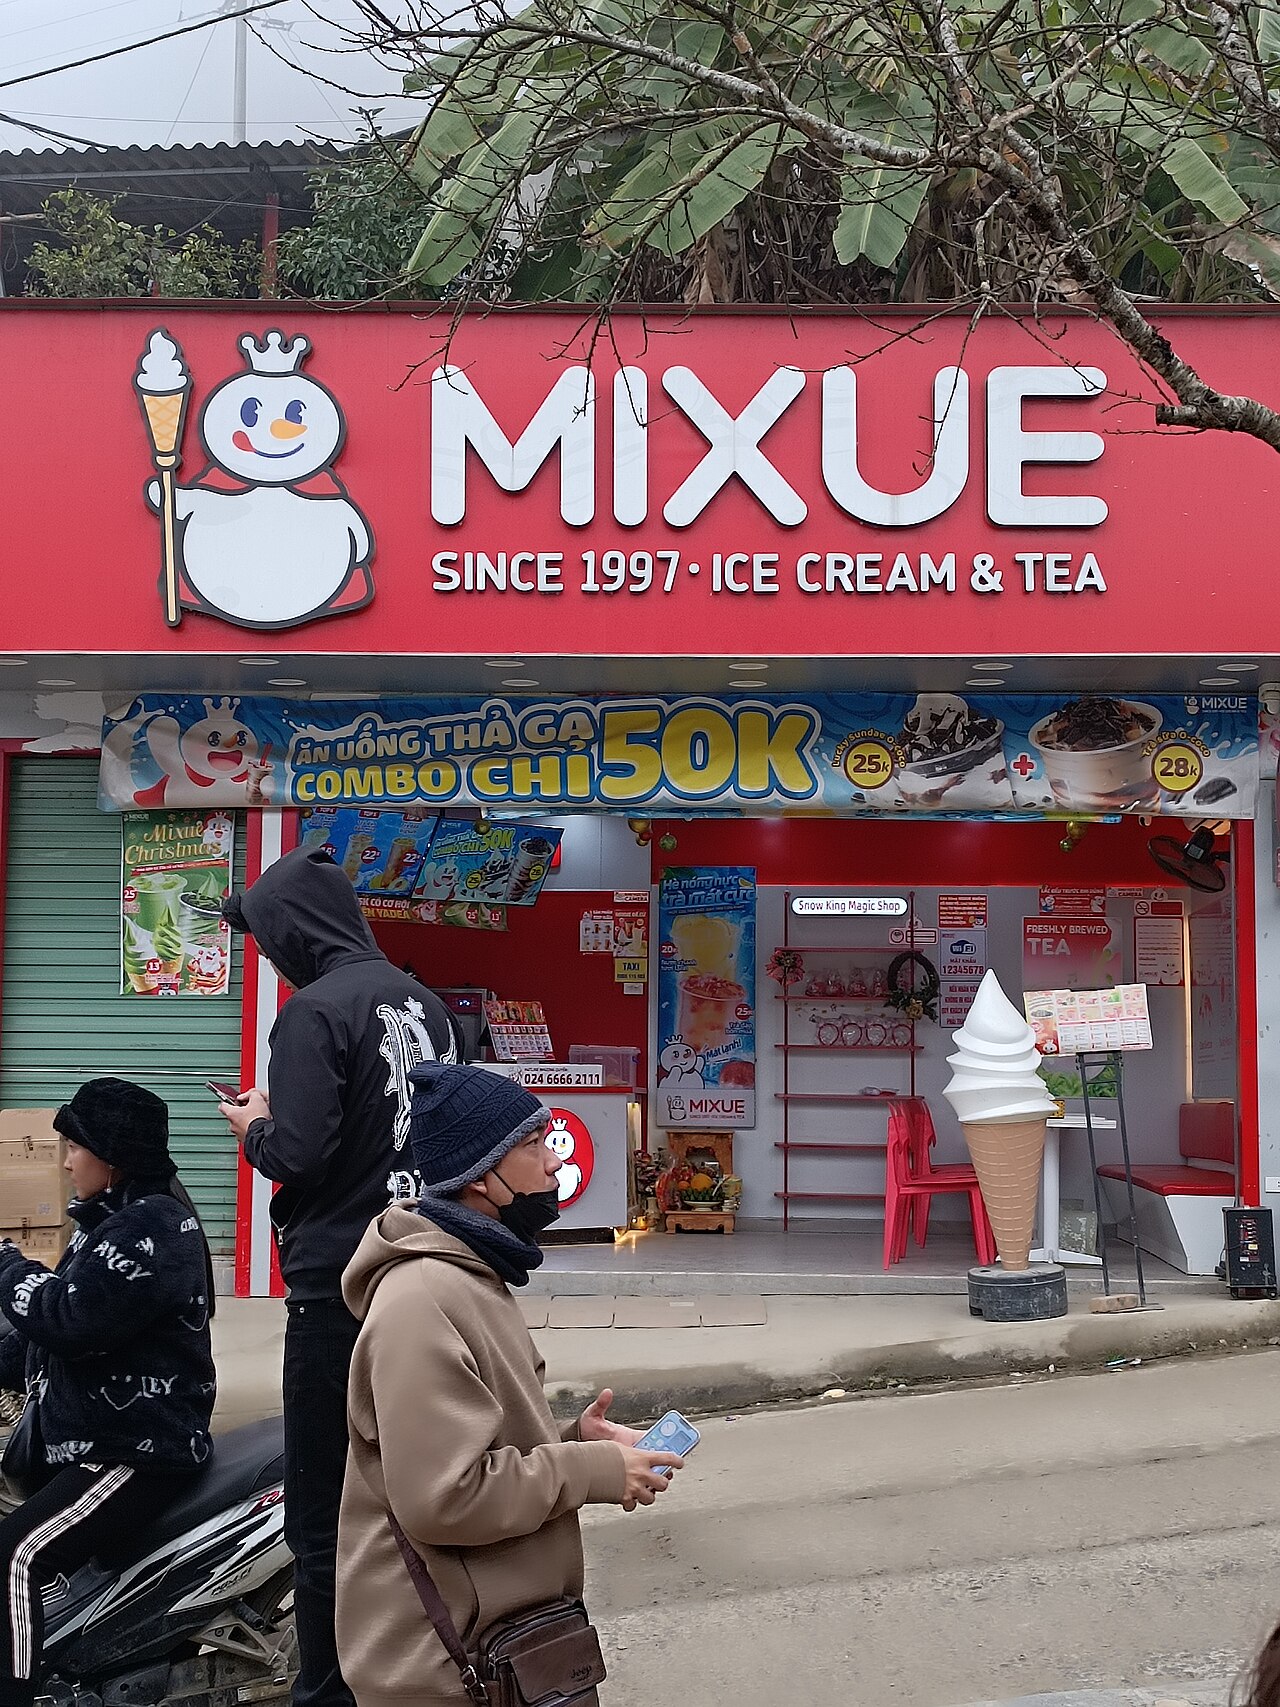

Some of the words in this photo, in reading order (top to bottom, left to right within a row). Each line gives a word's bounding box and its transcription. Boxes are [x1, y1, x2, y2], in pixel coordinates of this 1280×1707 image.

[430, 365, 1109, 526] MIXUE
[431, 551, 563, 593] SINCE
[581, 551, 678, 593] 1997
[712, 551, 780, 593] ICE
[797, 551, 956, 593] CREAM
[970, 551, 1004, 593] &
[1014, 551, 1107, 593] TEA
[1202, 697, 1247, 709] MIXUE
[296, 740, 329, 766] ĂN
[337, 722, 421, 761] UỐNG
[429, 710, 512, 752] THẢ
[600, 709, 813, 800] 50K
[831, 738, 850, 767] Lucky
[296, 760, 456, 801] COMBO
[471, 740, 590, 798] CHỈ
[125, 842, 221, 865] Christmas
[799, 900, 823, 910] Snow
[825, 900, 846, 913] King
[848, 900, 875, 913] Magic
[877, 900, 900, 913] Shop
[1027, 924, 1067, 934] FRESHLY
[1069, 925, 1108, 934] BREWED
[1027, 938, 1071, 955] TEA
[622, 963, 640, 971] TAXI
[942, 965, 985, 974] 12345678
[524, 1074, 544, 1084] 024
[547, 1074, 572, 1084] 6666
[575, 1074, 600, 1084] 2111
[690, 1099, 745, 1113] MIXUE
